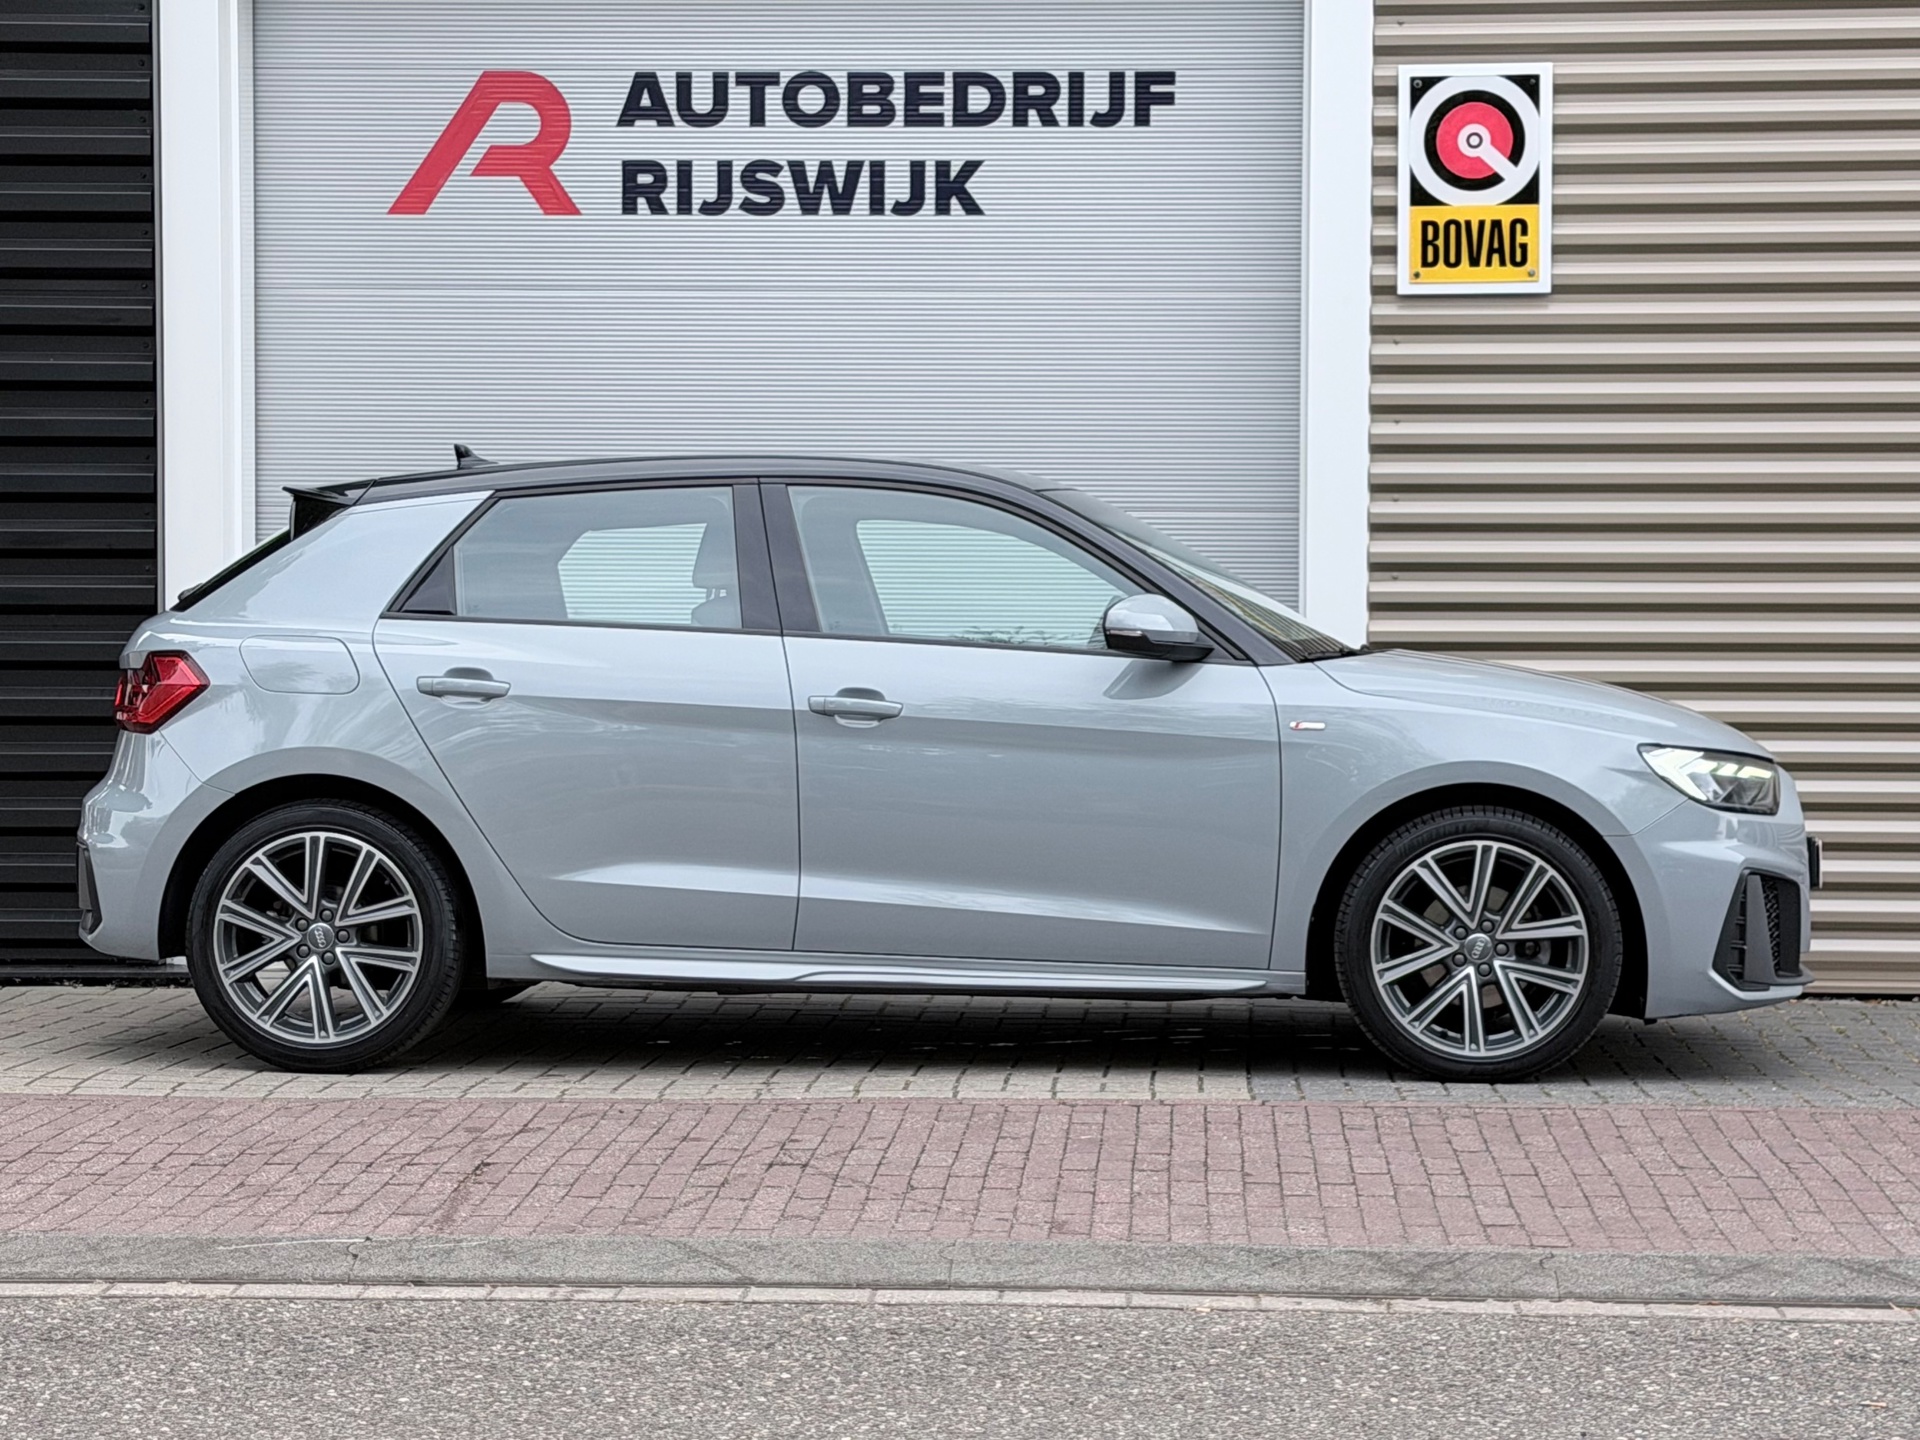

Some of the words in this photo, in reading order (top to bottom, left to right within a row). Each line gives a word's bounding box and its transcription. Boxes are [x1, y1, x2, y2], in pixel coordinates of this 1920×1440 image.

[616, 70, 1176, 128] AUTOBEDRIJF
[621, 159, 985, 217] RIJSWIJK
[1420, 218, 1529, 269] BOVAG
